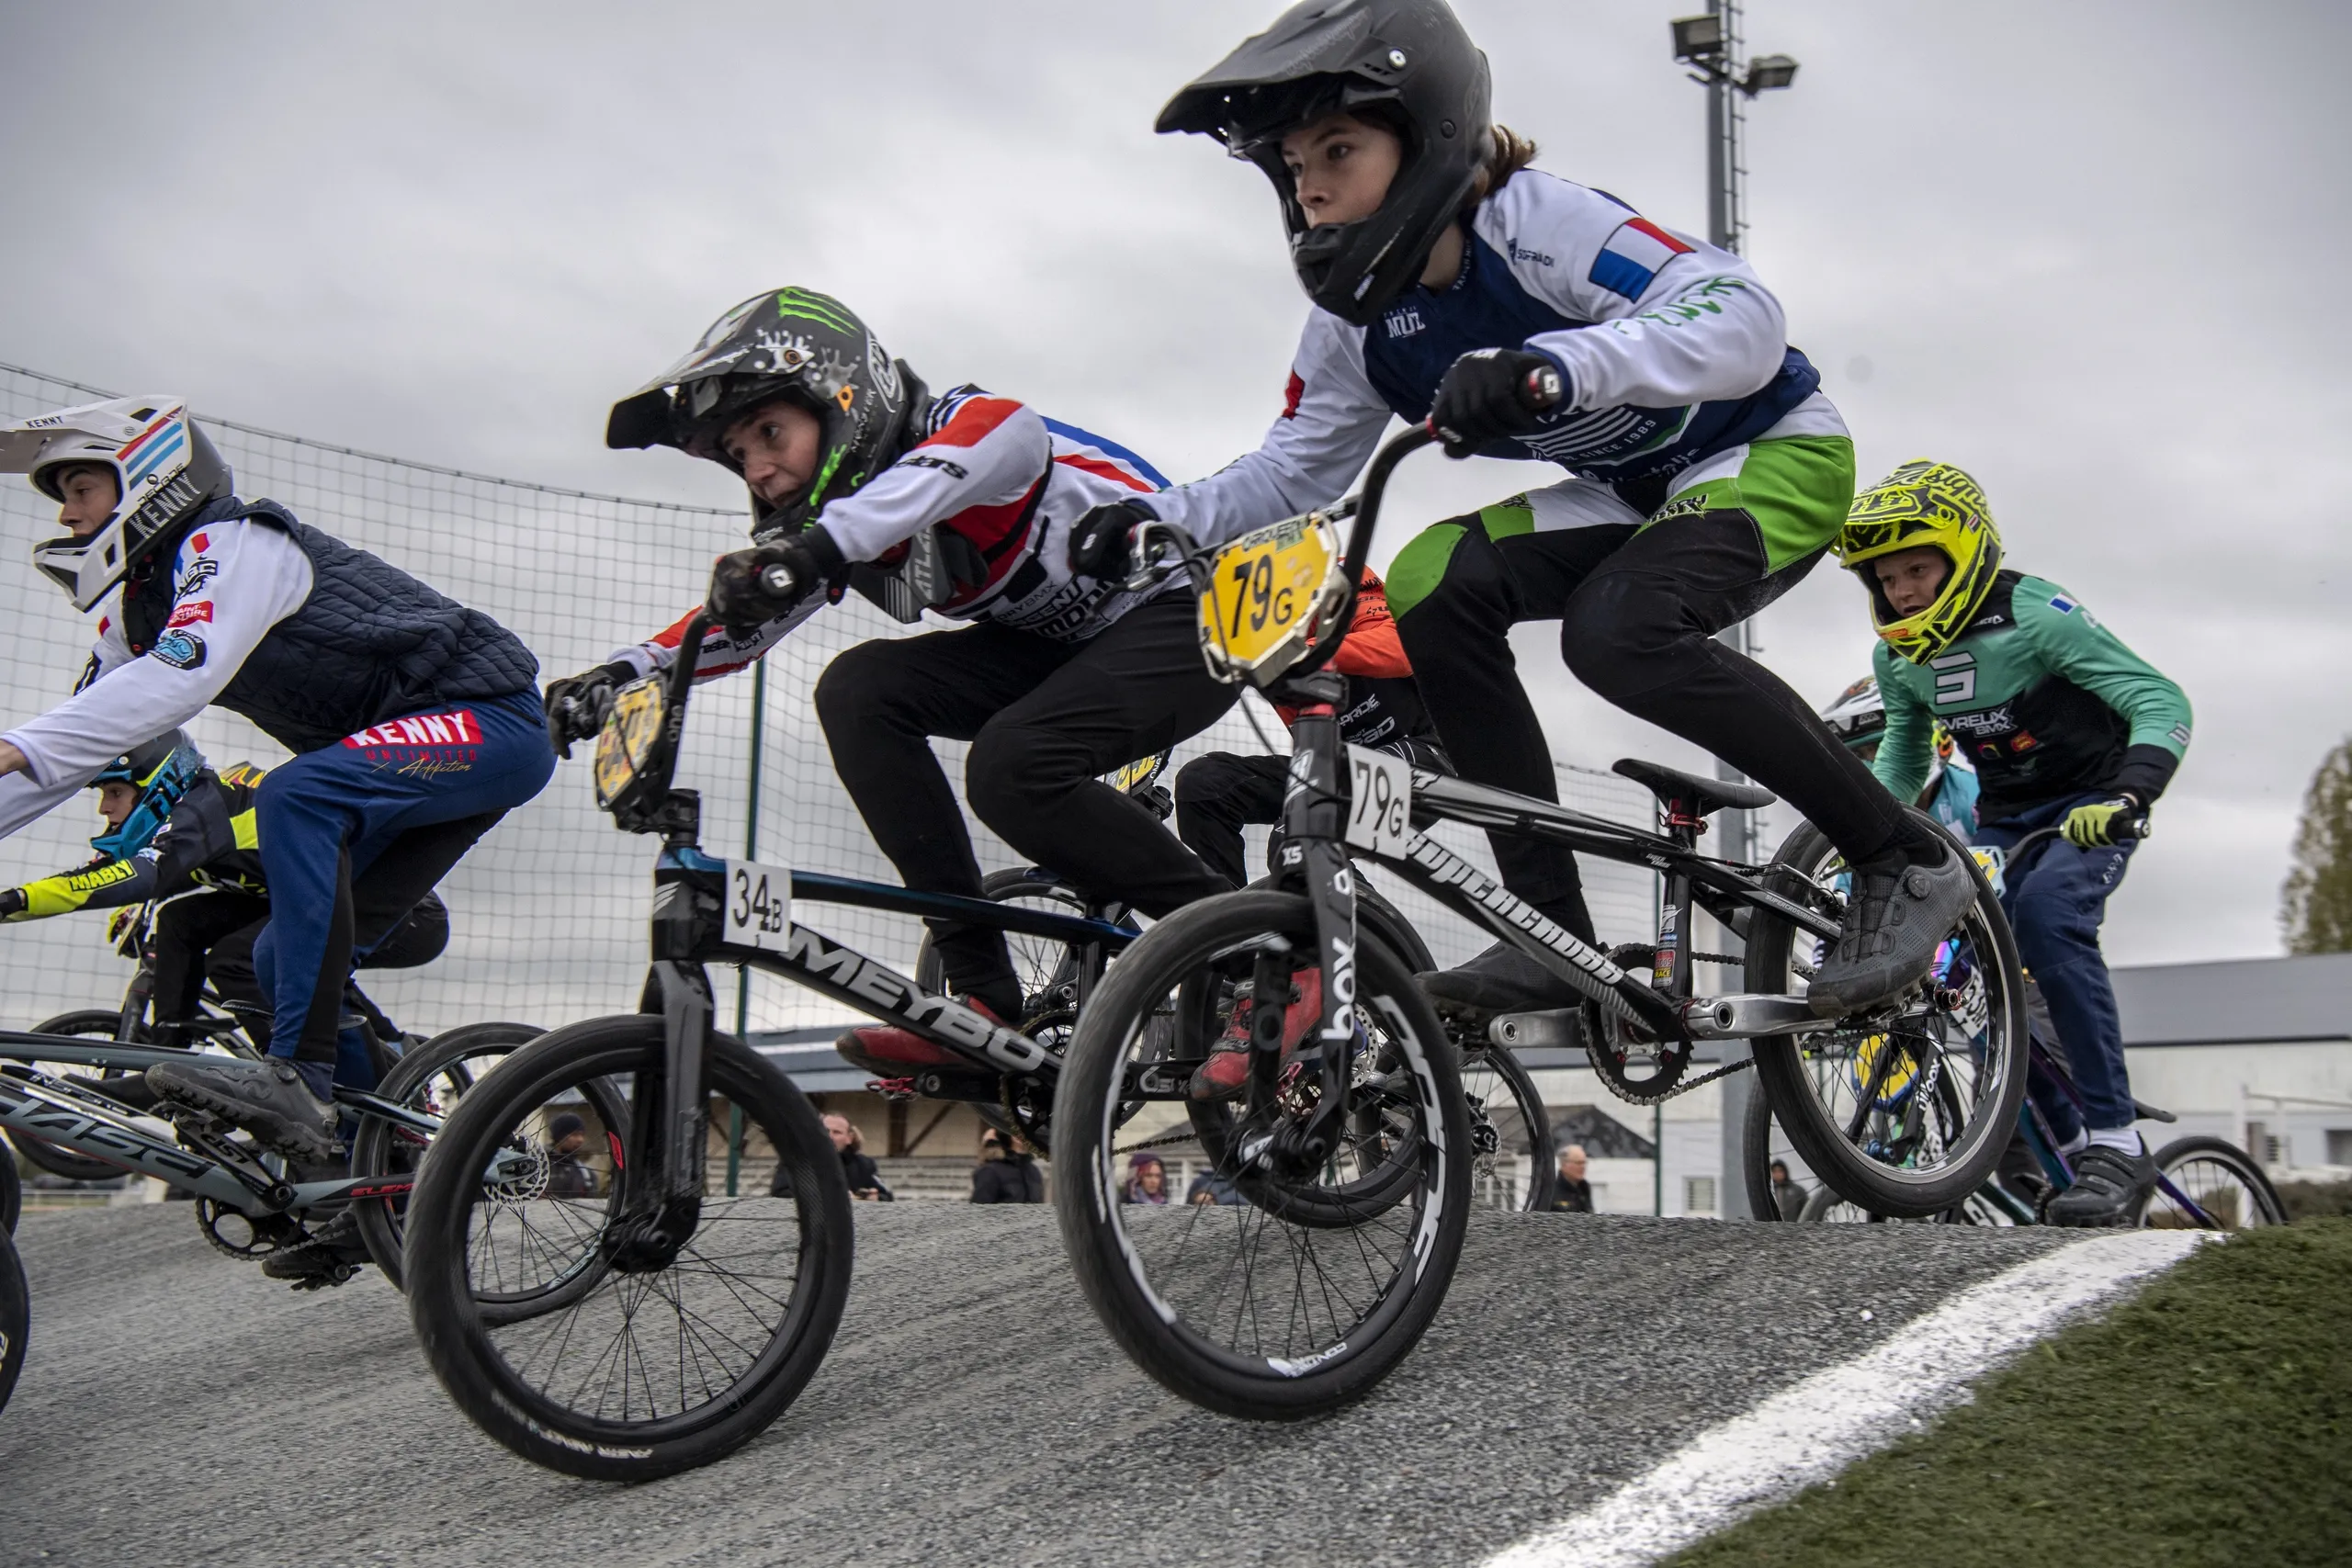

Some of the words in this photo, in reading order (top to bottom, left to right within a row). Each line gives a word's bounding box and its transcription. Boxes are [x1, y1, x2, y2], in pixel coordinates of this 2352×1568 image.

[26, 415, 64, 429] KENNY
[1578, 441, 1623, 459] SINCE
[1623, 420, 1657, 445] 1989
[129, 470, 201, 540] KENNY
[349, 713, 469, 747] KENNY
[1942, 706, 2007, 731] VREUX
[1975, 721, 2011, 736] BMX
[366, 750, 477, 761] UNLIMITED
[71, 861, 135, 891] MABLY
[1765, 894, 1831, 931] SUPERCROSSBMX.COM
[778, 926, 1046, 1071] MEYBO
[1321, 937, 1356, 1040] box
